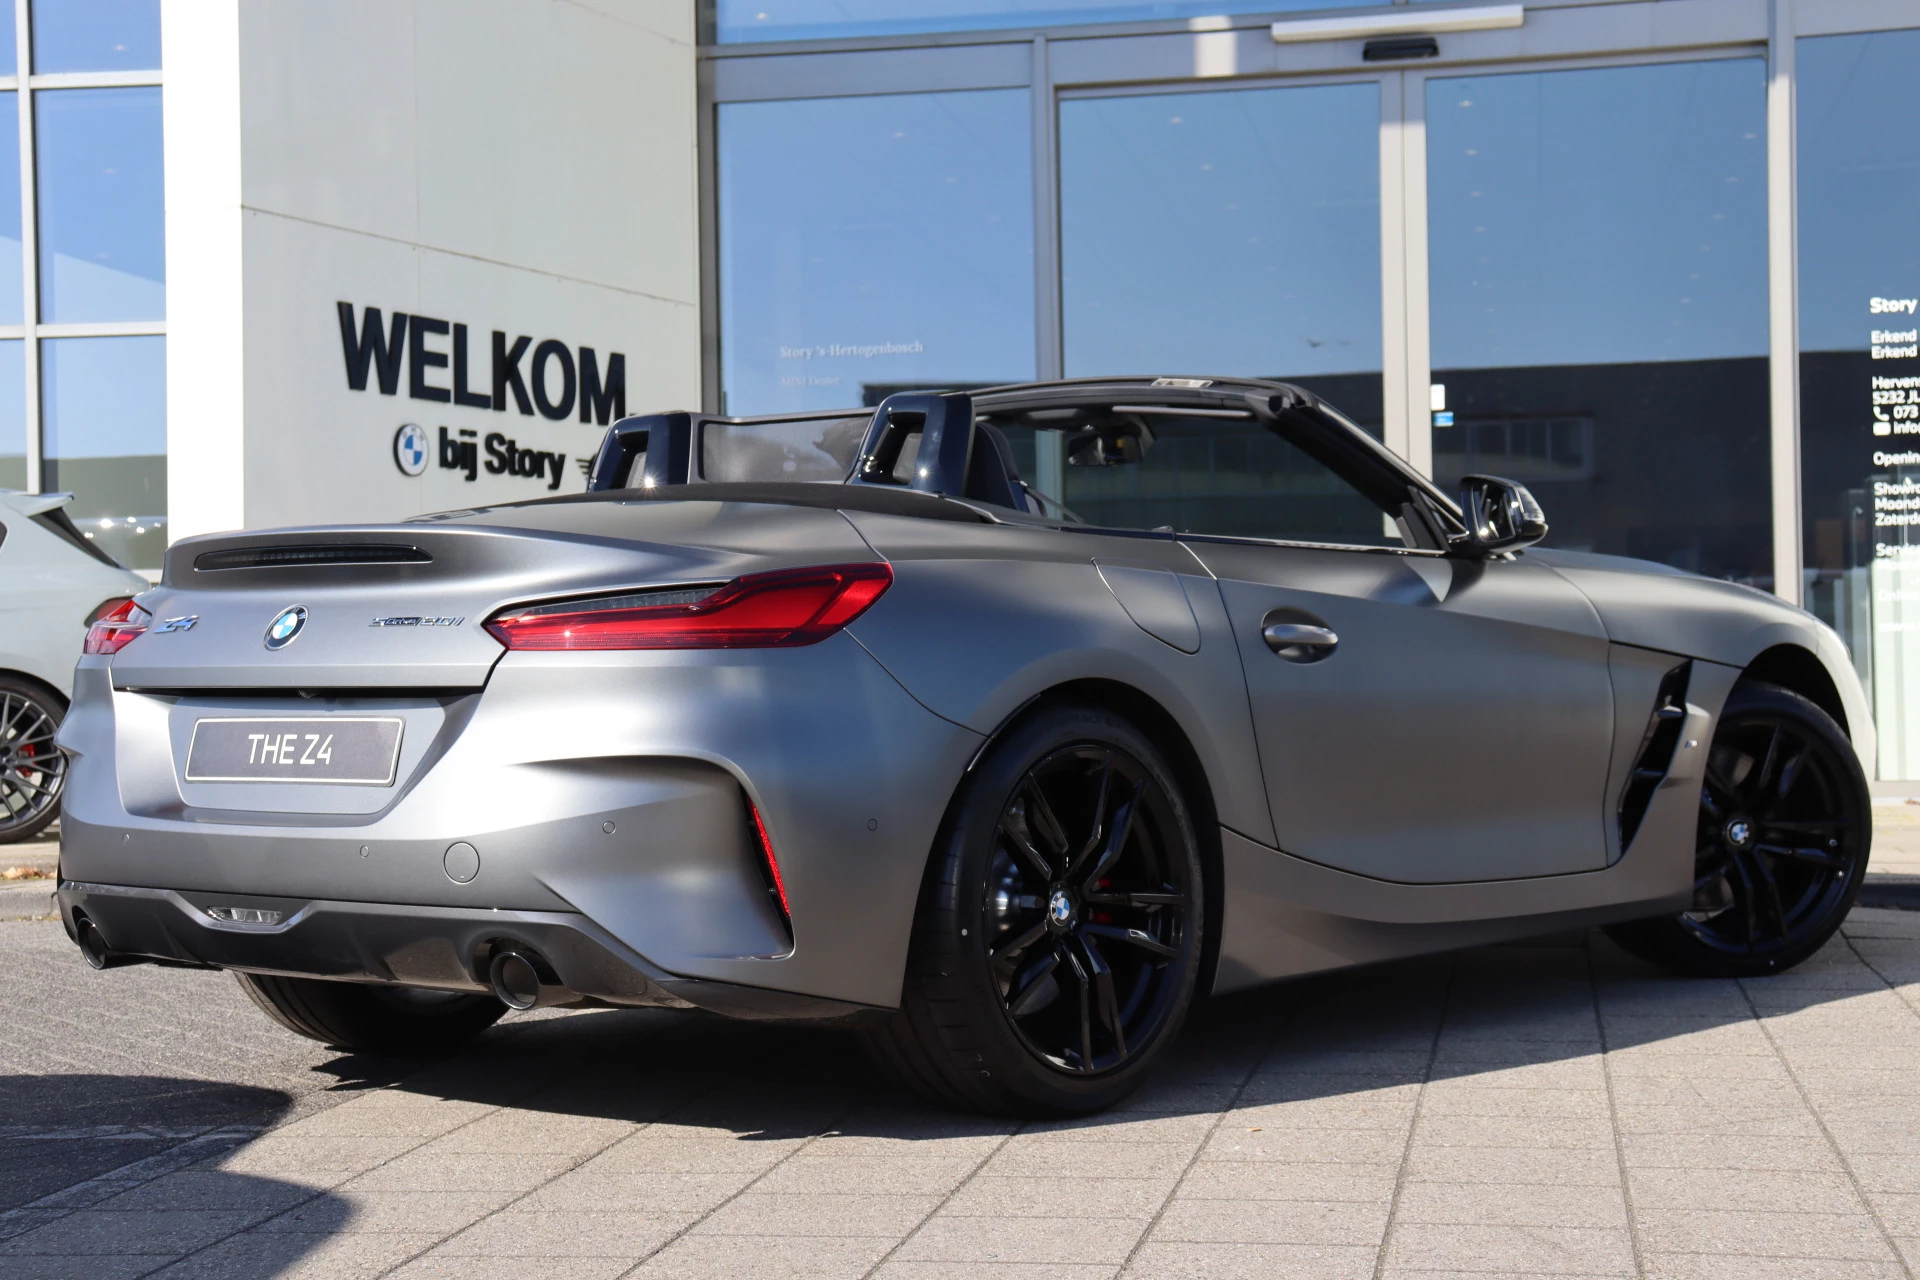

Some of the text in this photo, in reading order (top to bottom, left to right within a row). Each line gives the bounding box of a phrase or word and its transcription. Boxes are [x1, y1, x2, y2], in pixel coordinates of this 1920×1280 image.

[1869, 297, 1918, 314] Story
[780, 345, 813, 360] Story
[337, 301, 626, 426] WELKOM
[1872, 376, 1920, 390] Herven
[1872, 391, 1905, 405] 5232
[1893, 405, 1919, 420] 073
[438, 426, 566, 490] bij Story
[154, 615, 199, 634] Z4
[248, 734, 334, 765] THE Z4
